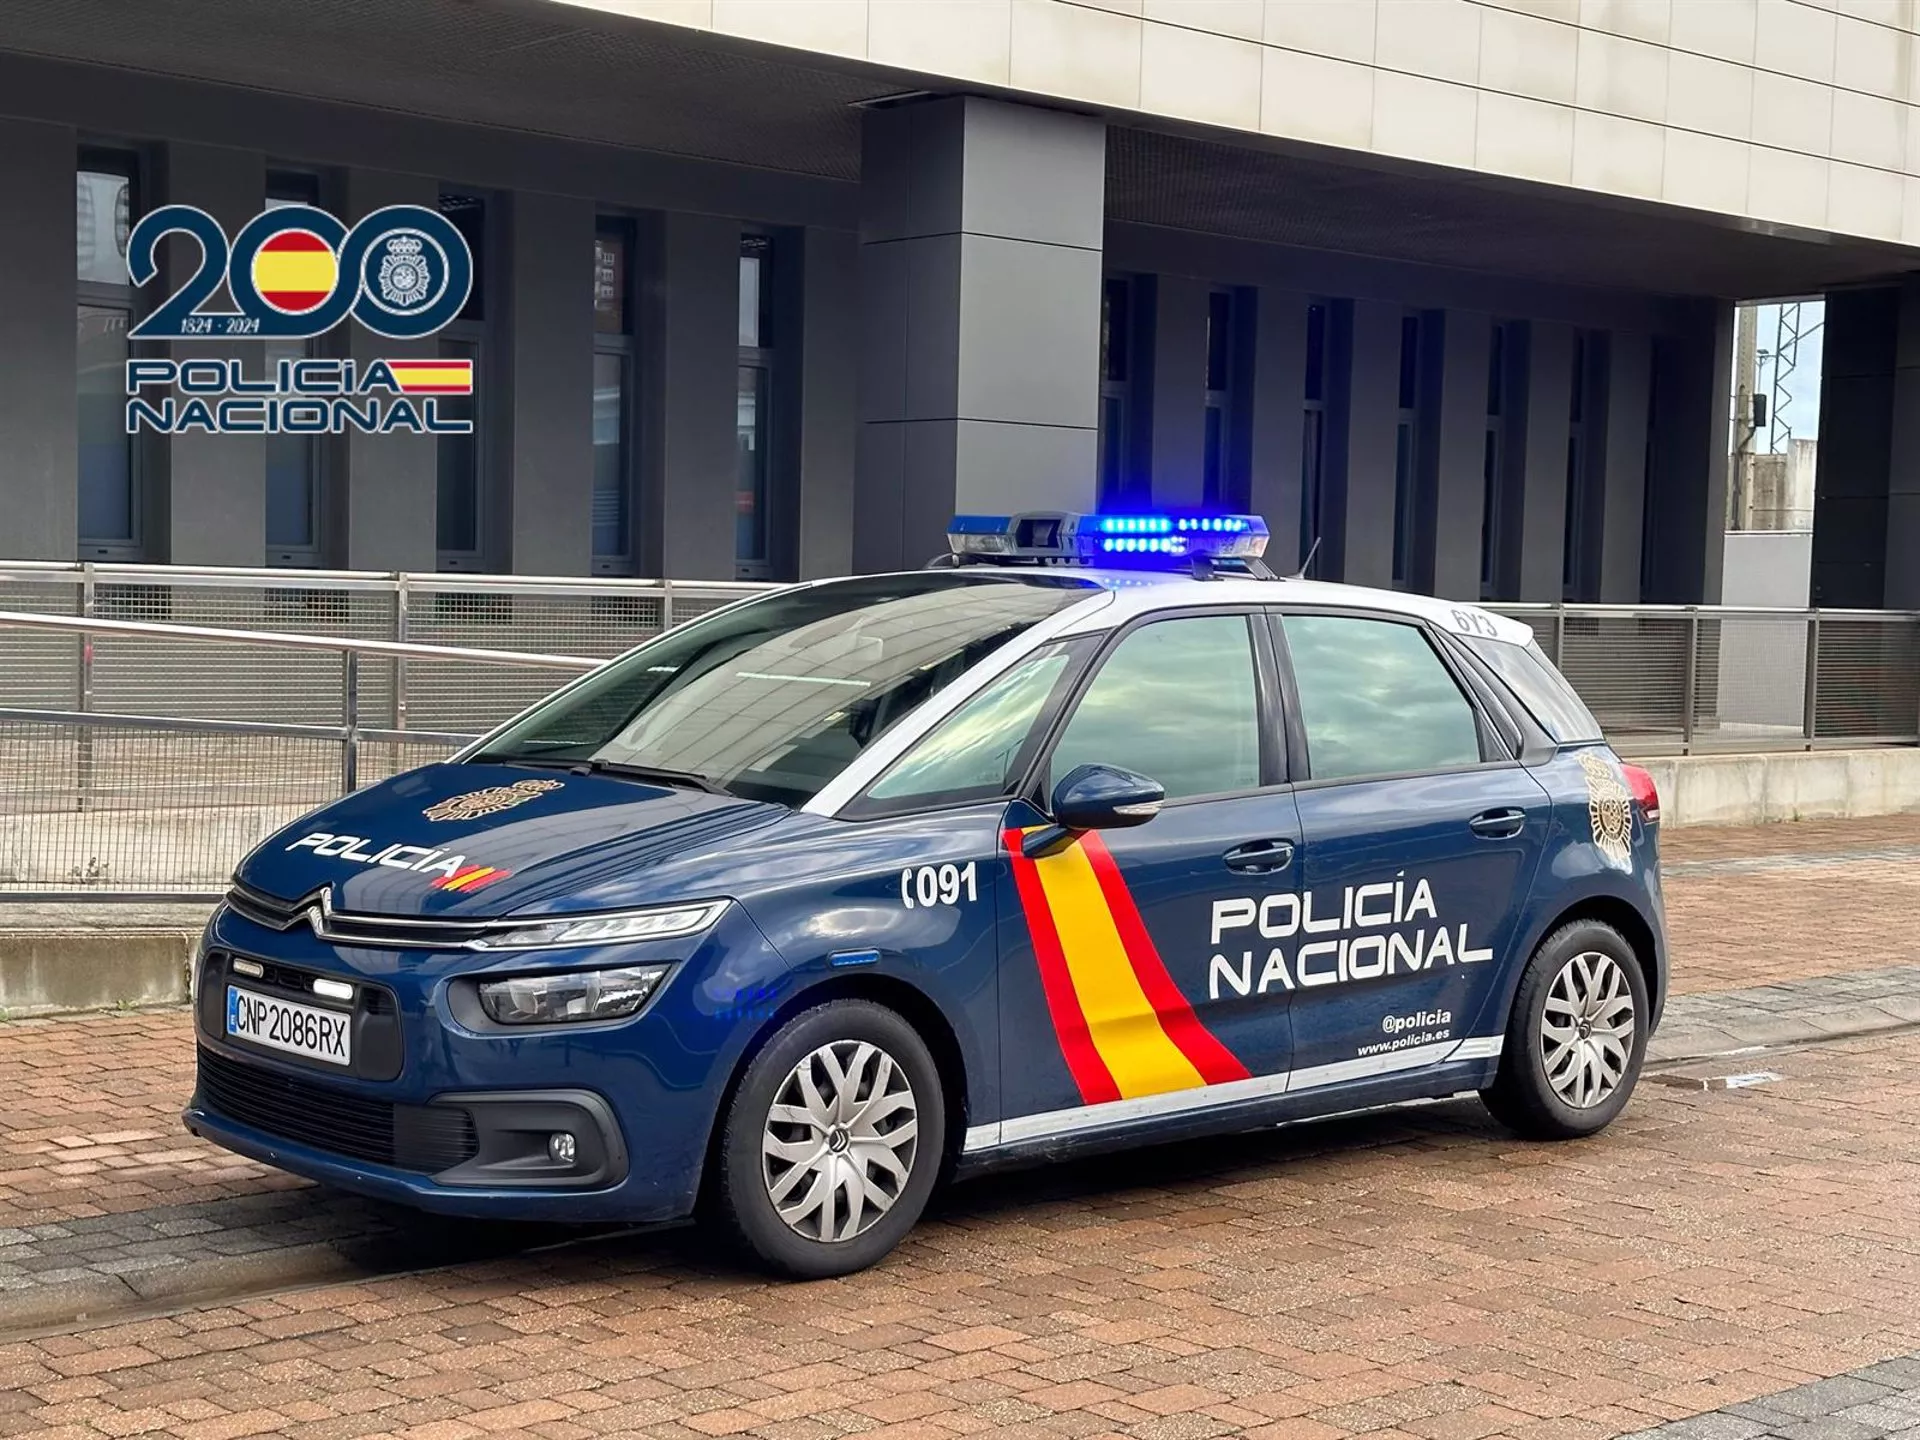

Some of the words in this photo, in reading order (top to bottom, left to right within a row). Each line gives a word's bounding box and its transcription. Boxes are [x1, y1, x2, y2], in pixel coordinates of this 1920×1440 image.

[285, 832, 467, 878] POLICÍA
[1210, 870, 1438, 945] POLICÍA
[1208, 923, 1494, 1000] NACIONAL
[1357, 1028, 1450, 1057] www.policia.es
[1382, 1009, 1452, 1034] @policia
